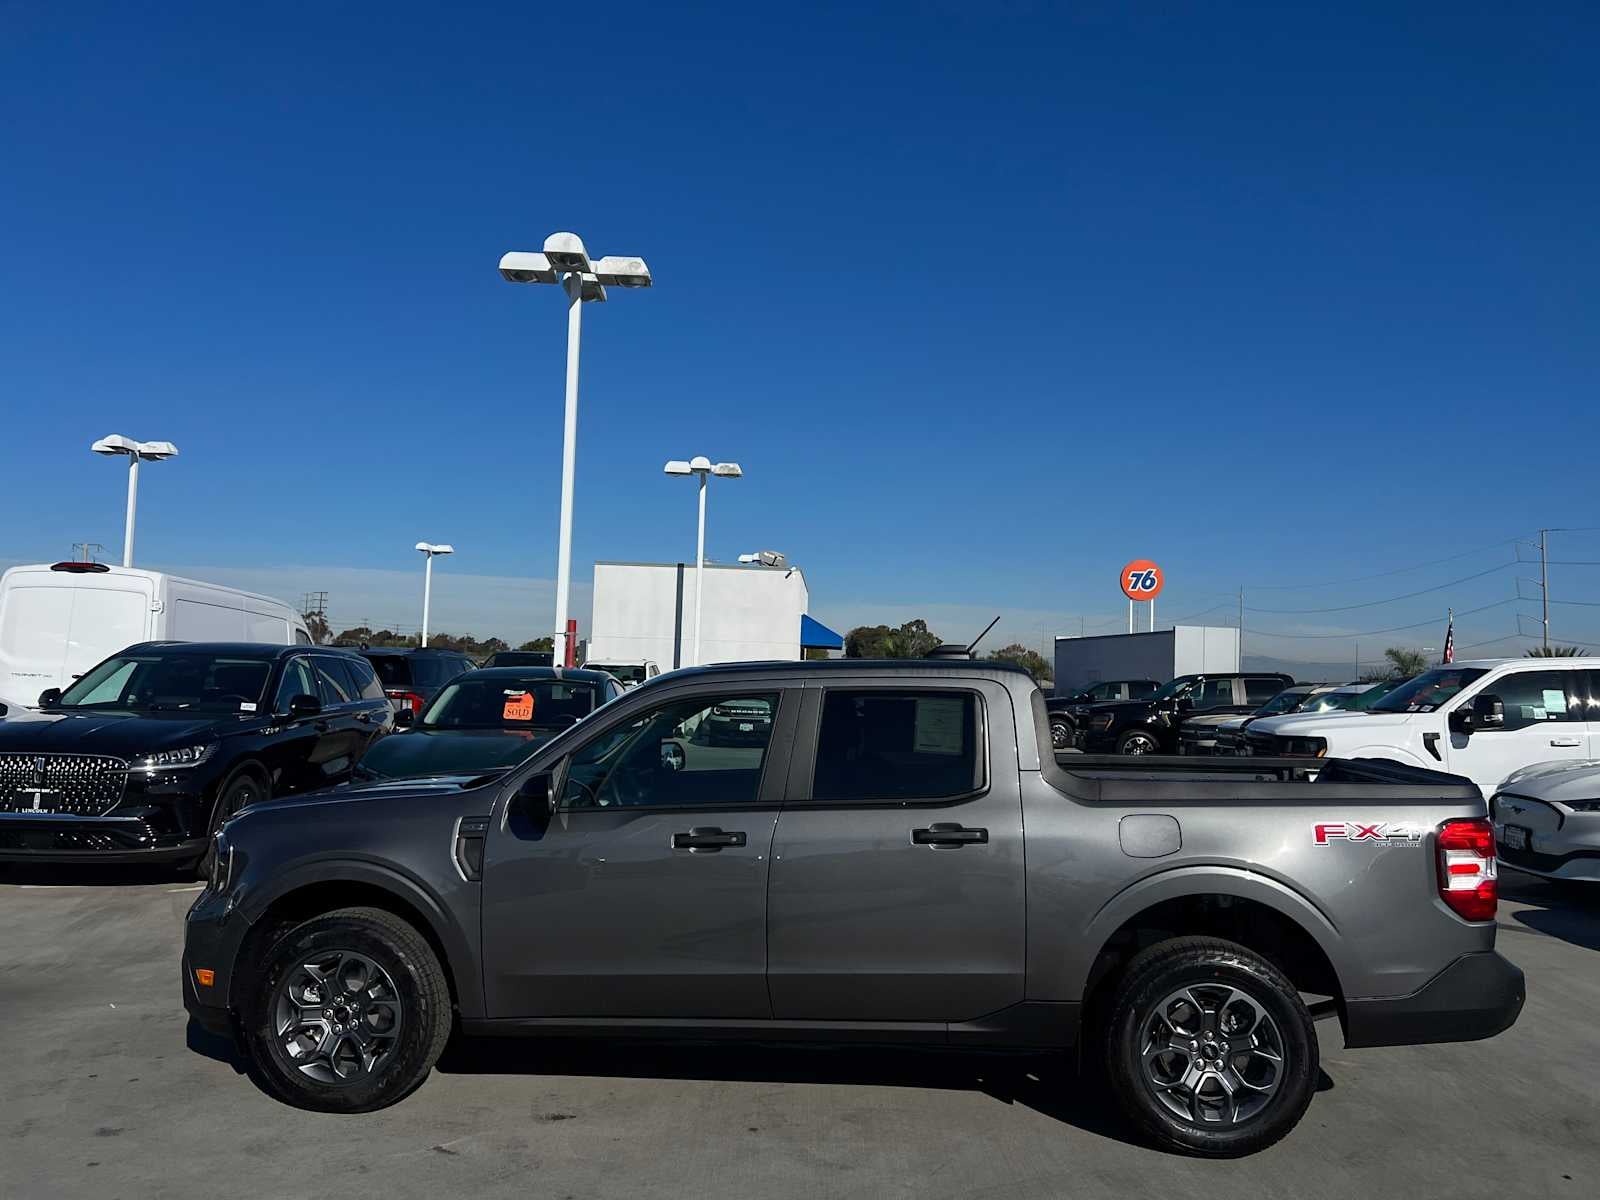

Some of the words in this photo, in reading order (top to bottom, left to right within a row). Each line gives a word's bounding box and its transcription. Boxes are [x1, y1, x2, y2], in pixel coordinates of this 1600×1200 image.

[1128, 568, 1157, 592] 76
[506, 708, 530, 718] SOLD
[1312, 822, 1421, 847] FX4
